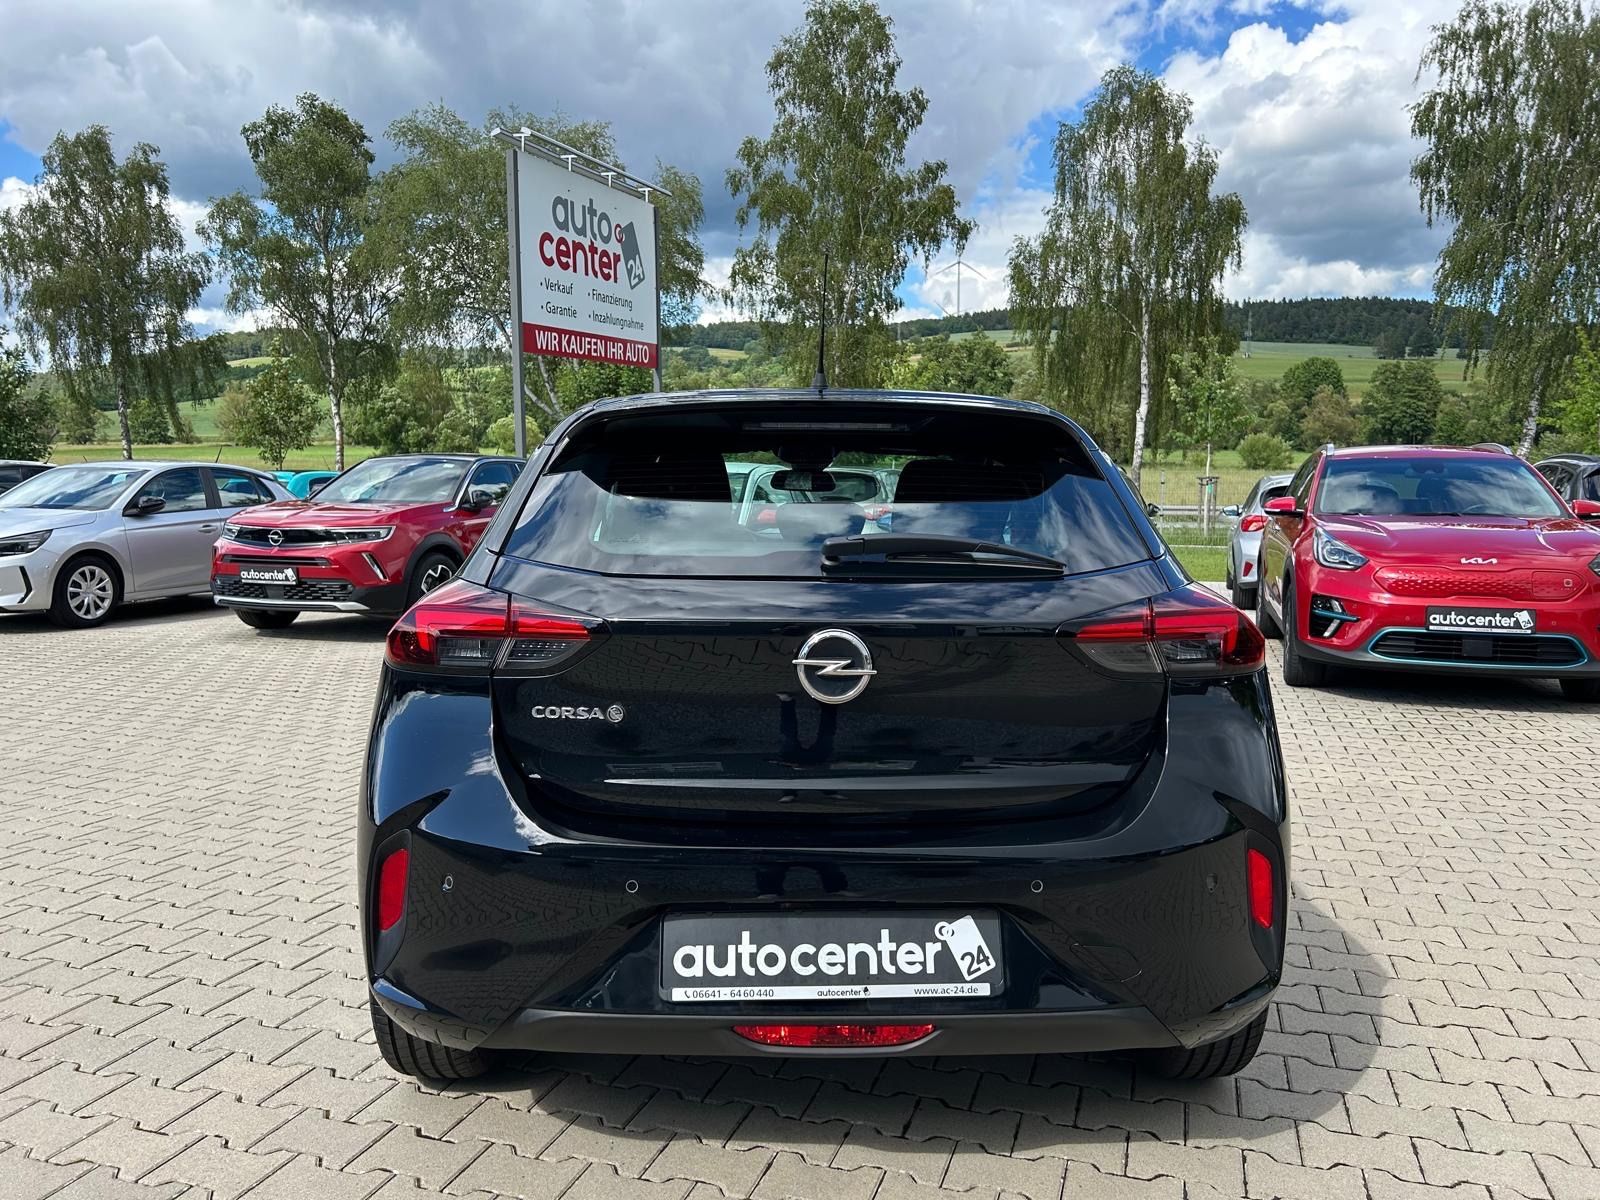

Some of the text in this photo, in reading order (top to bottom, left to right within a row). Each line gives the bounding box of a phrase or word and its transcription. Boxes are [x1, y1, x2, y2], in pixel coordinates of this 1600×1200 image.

[552, 196, 612, 244] auto
[539, 232, 621, 283] center
[627, 255, 644, 281] 24
[544, 278, 573, 295] Verkauf
[592, 289, 633, 311] Finanzierung
[545, 301, 578, 319] Garantie
[592, 310, 645, 331] Inzahlungnahme
[535, 329, 650, 364] WIR KAUFEN IHR AUTO
[241, 569, 286, 580] autocenter
[1429, 611, 1516, 627] autocenter
[531, 706, 605, 719] CORSA
[673, 929, 942, 977] autocenter
[960, 945, 991, 976] 24
[692, 989, 721, 998] 06641
[817, 988, 862, 997] autocenter
[914, 985, 979, 995] www.ac-24.de
